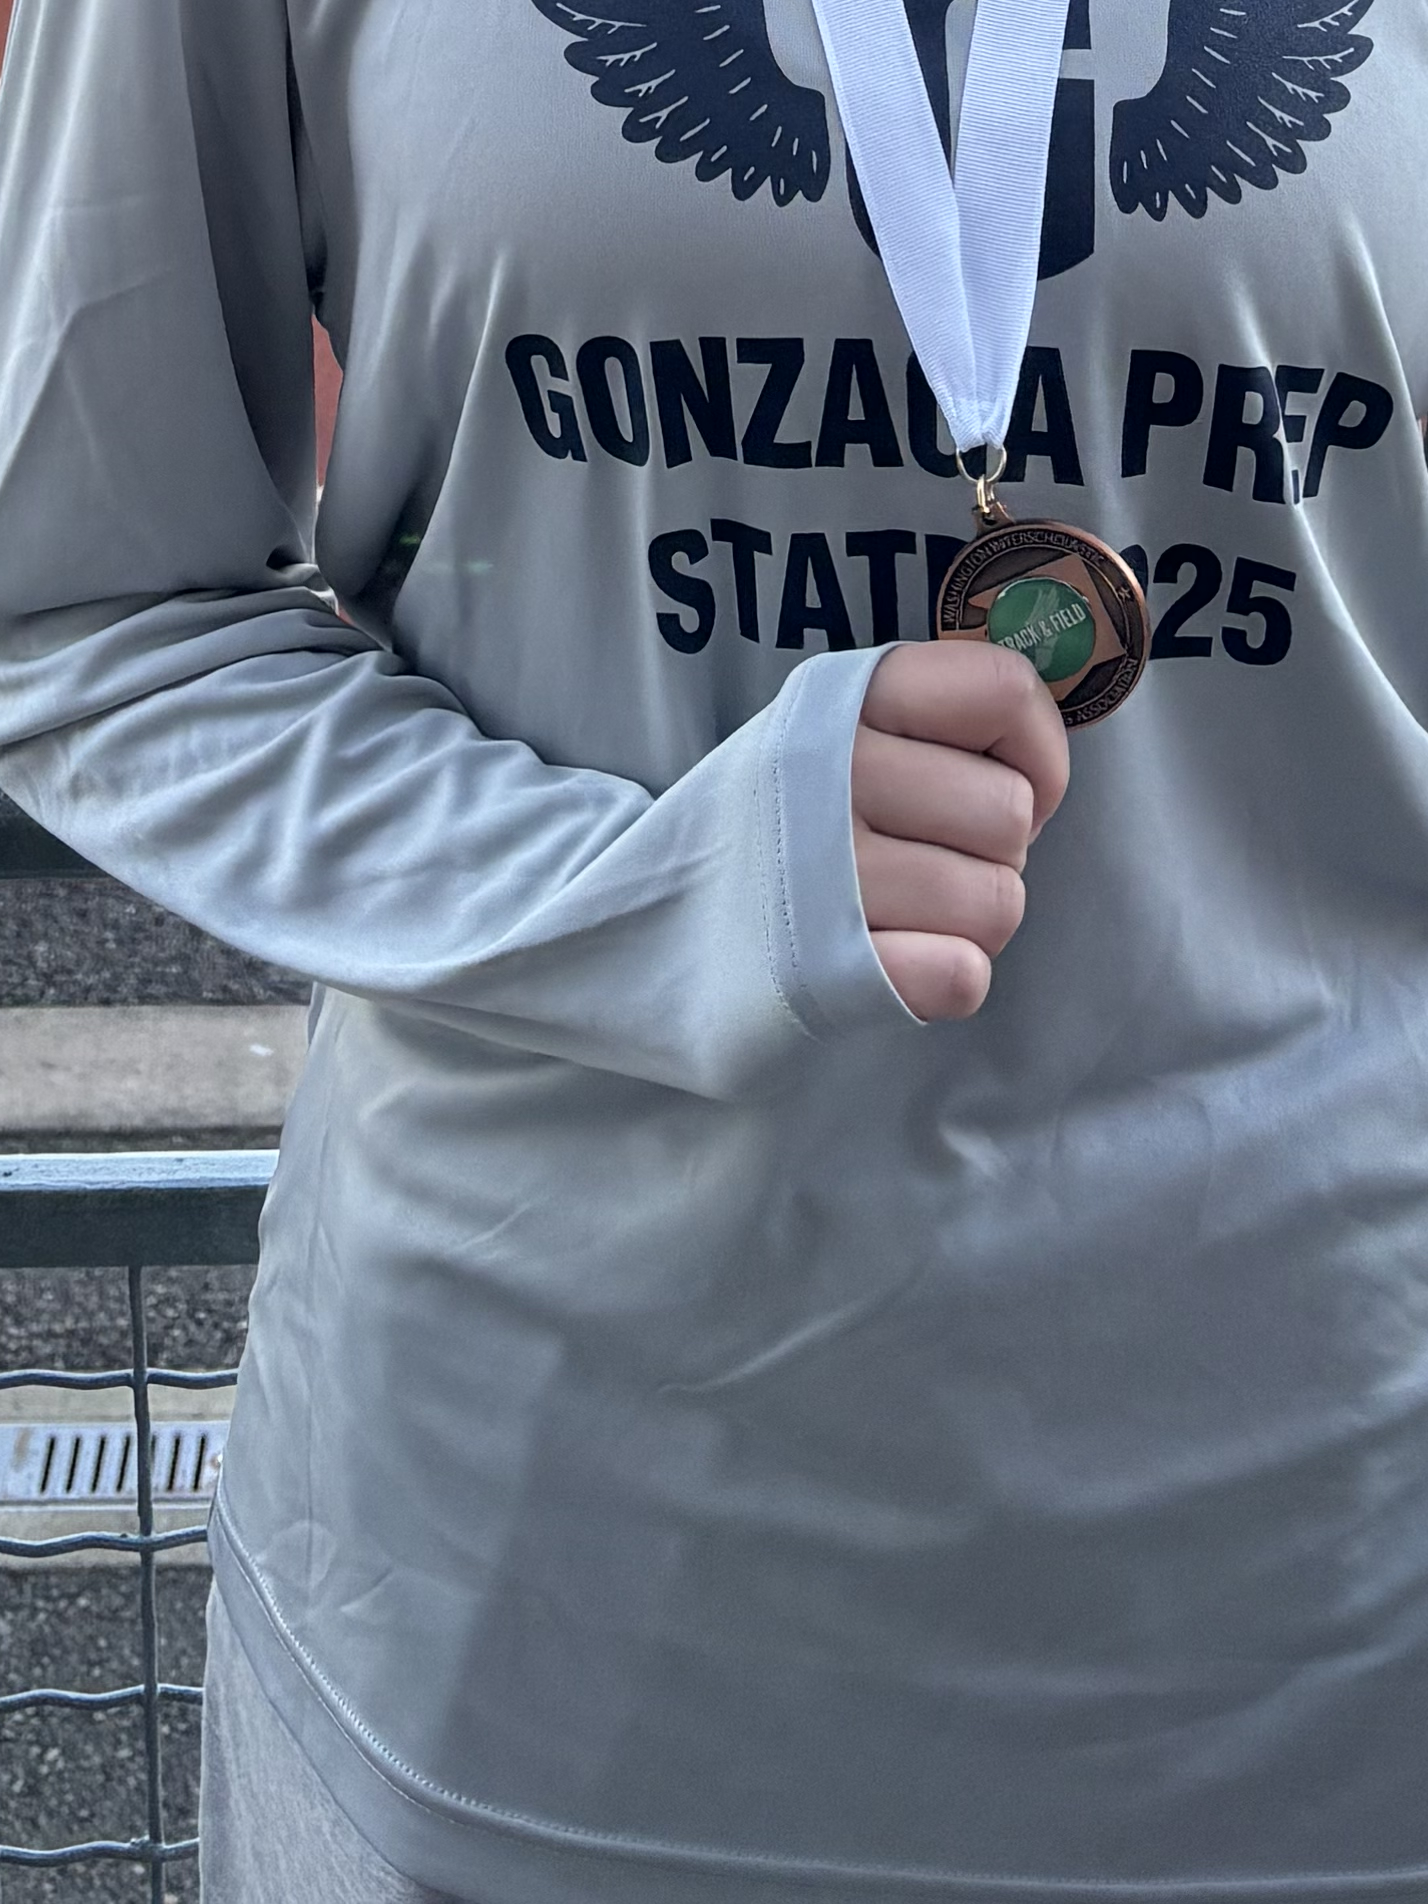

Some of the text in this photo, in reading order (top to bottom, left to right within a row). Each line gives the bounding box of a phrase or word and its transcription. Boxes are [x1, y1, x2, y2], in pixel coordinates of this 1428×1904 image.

[1120, 349, 1395, 505] PREP
[1038, 620, 1053, 637] &
[1049, 603, 1087, 633] FIELD
